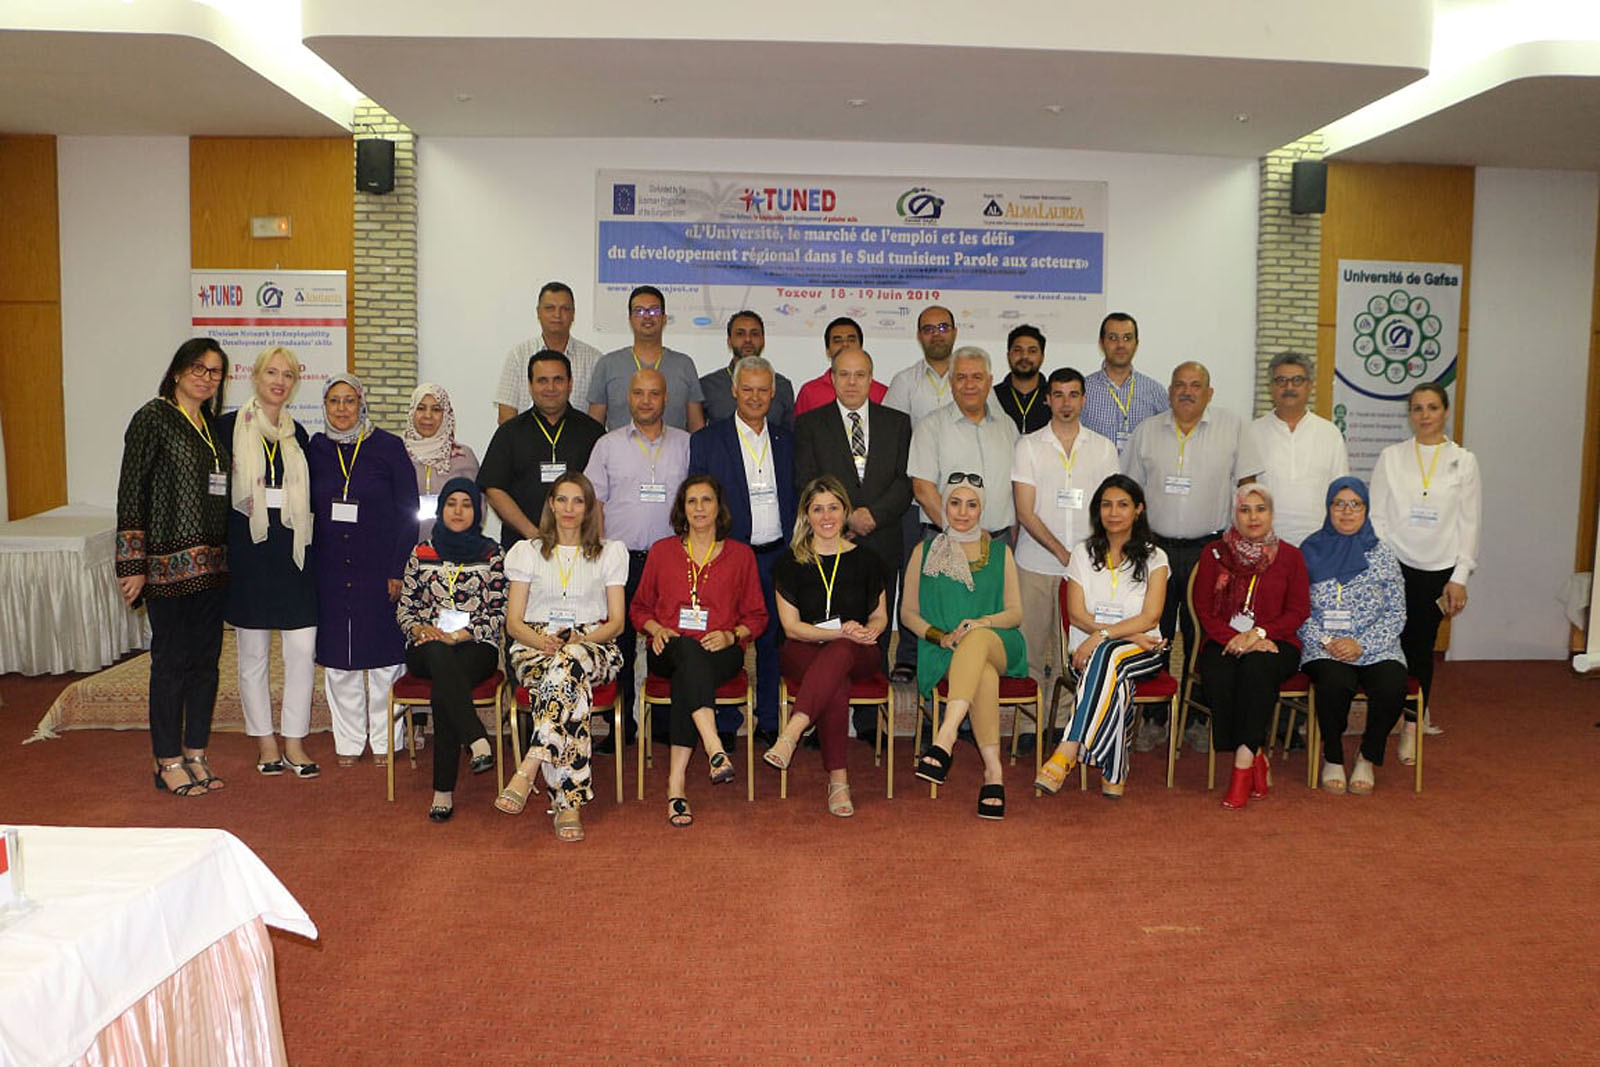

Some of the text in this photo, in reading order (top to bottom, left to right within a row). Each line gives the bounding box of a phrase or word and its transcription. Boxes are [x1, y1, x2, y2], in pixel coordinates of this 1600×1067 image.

[763, 187, 836, 212] TUNED
[788, 225, 800, 241] le
[804, 226, 857, 243] marché
[861, 229, 877, 243] de
[881, 229, 938, 246] l'emploi
[941, 231, 955, 244] et
[959, 230, 978, 245] les
[981, 231, 1015, 246] défis
[608, 245, 626, 259] du
[630, 244, 738, 264] développement
[742, 246, 800, 265] régional
[804, 248, 837, 263] dans
[841, 249, 854, 263] le
[857, 250, 884, 265] Sud
[888, 251, 950, 266] tunisien:
[954, 252, 999, 267] Parole
[1002, 256, 1028, 268] aux
[1343, 269, 1458, 286] Université de Gafsa
[209, 285, 243, 306] TUNED
[831, 289, 846, 299] 18
[859, 289, 873, 299] 19
[877, 289, 902, 300] Juin
[907, 290, 940, 301] 2019
